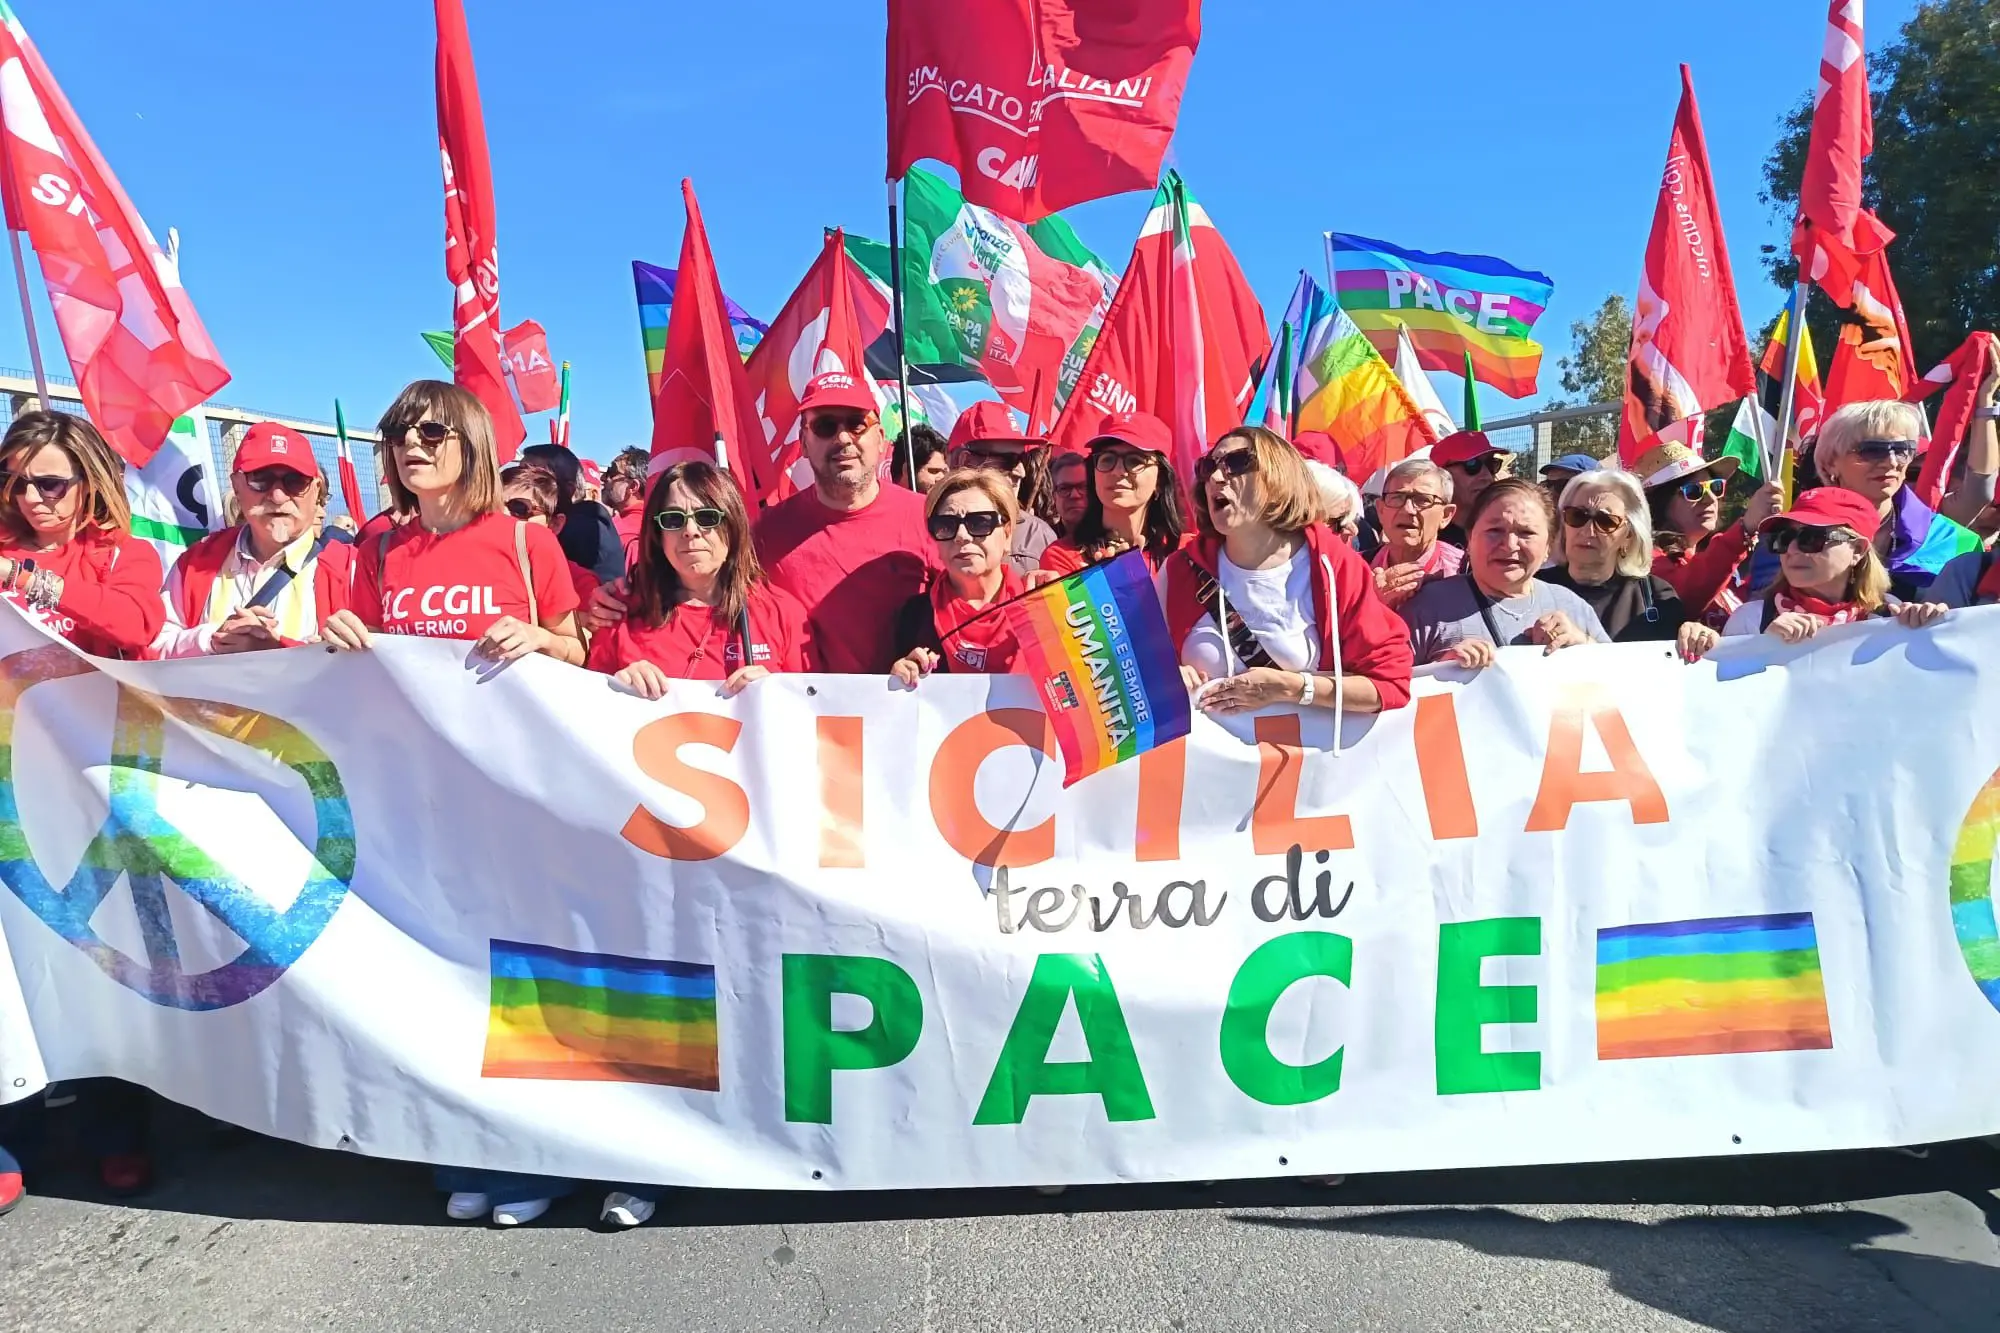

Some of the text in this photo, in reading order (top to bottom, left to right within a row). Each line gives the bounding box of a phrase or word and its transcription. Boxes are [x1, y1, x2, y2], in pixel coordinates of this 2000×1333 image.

[1385, 270, 1511, 335] PACE
[817, 374, 855, 386] CGIL
[388, 619, 467, 636] PALERMO
[420, 585, 502, 617] CGIL
[1065, 600, 1136, 752] UMANITÀ
[1100, 603, 1149, 723] ORA E SEMPRE
[620, 682, 1669, 869] SICILIA
[987, 843, 1354, 934] terra di
[781, 916, 1542, 1126] PACE
